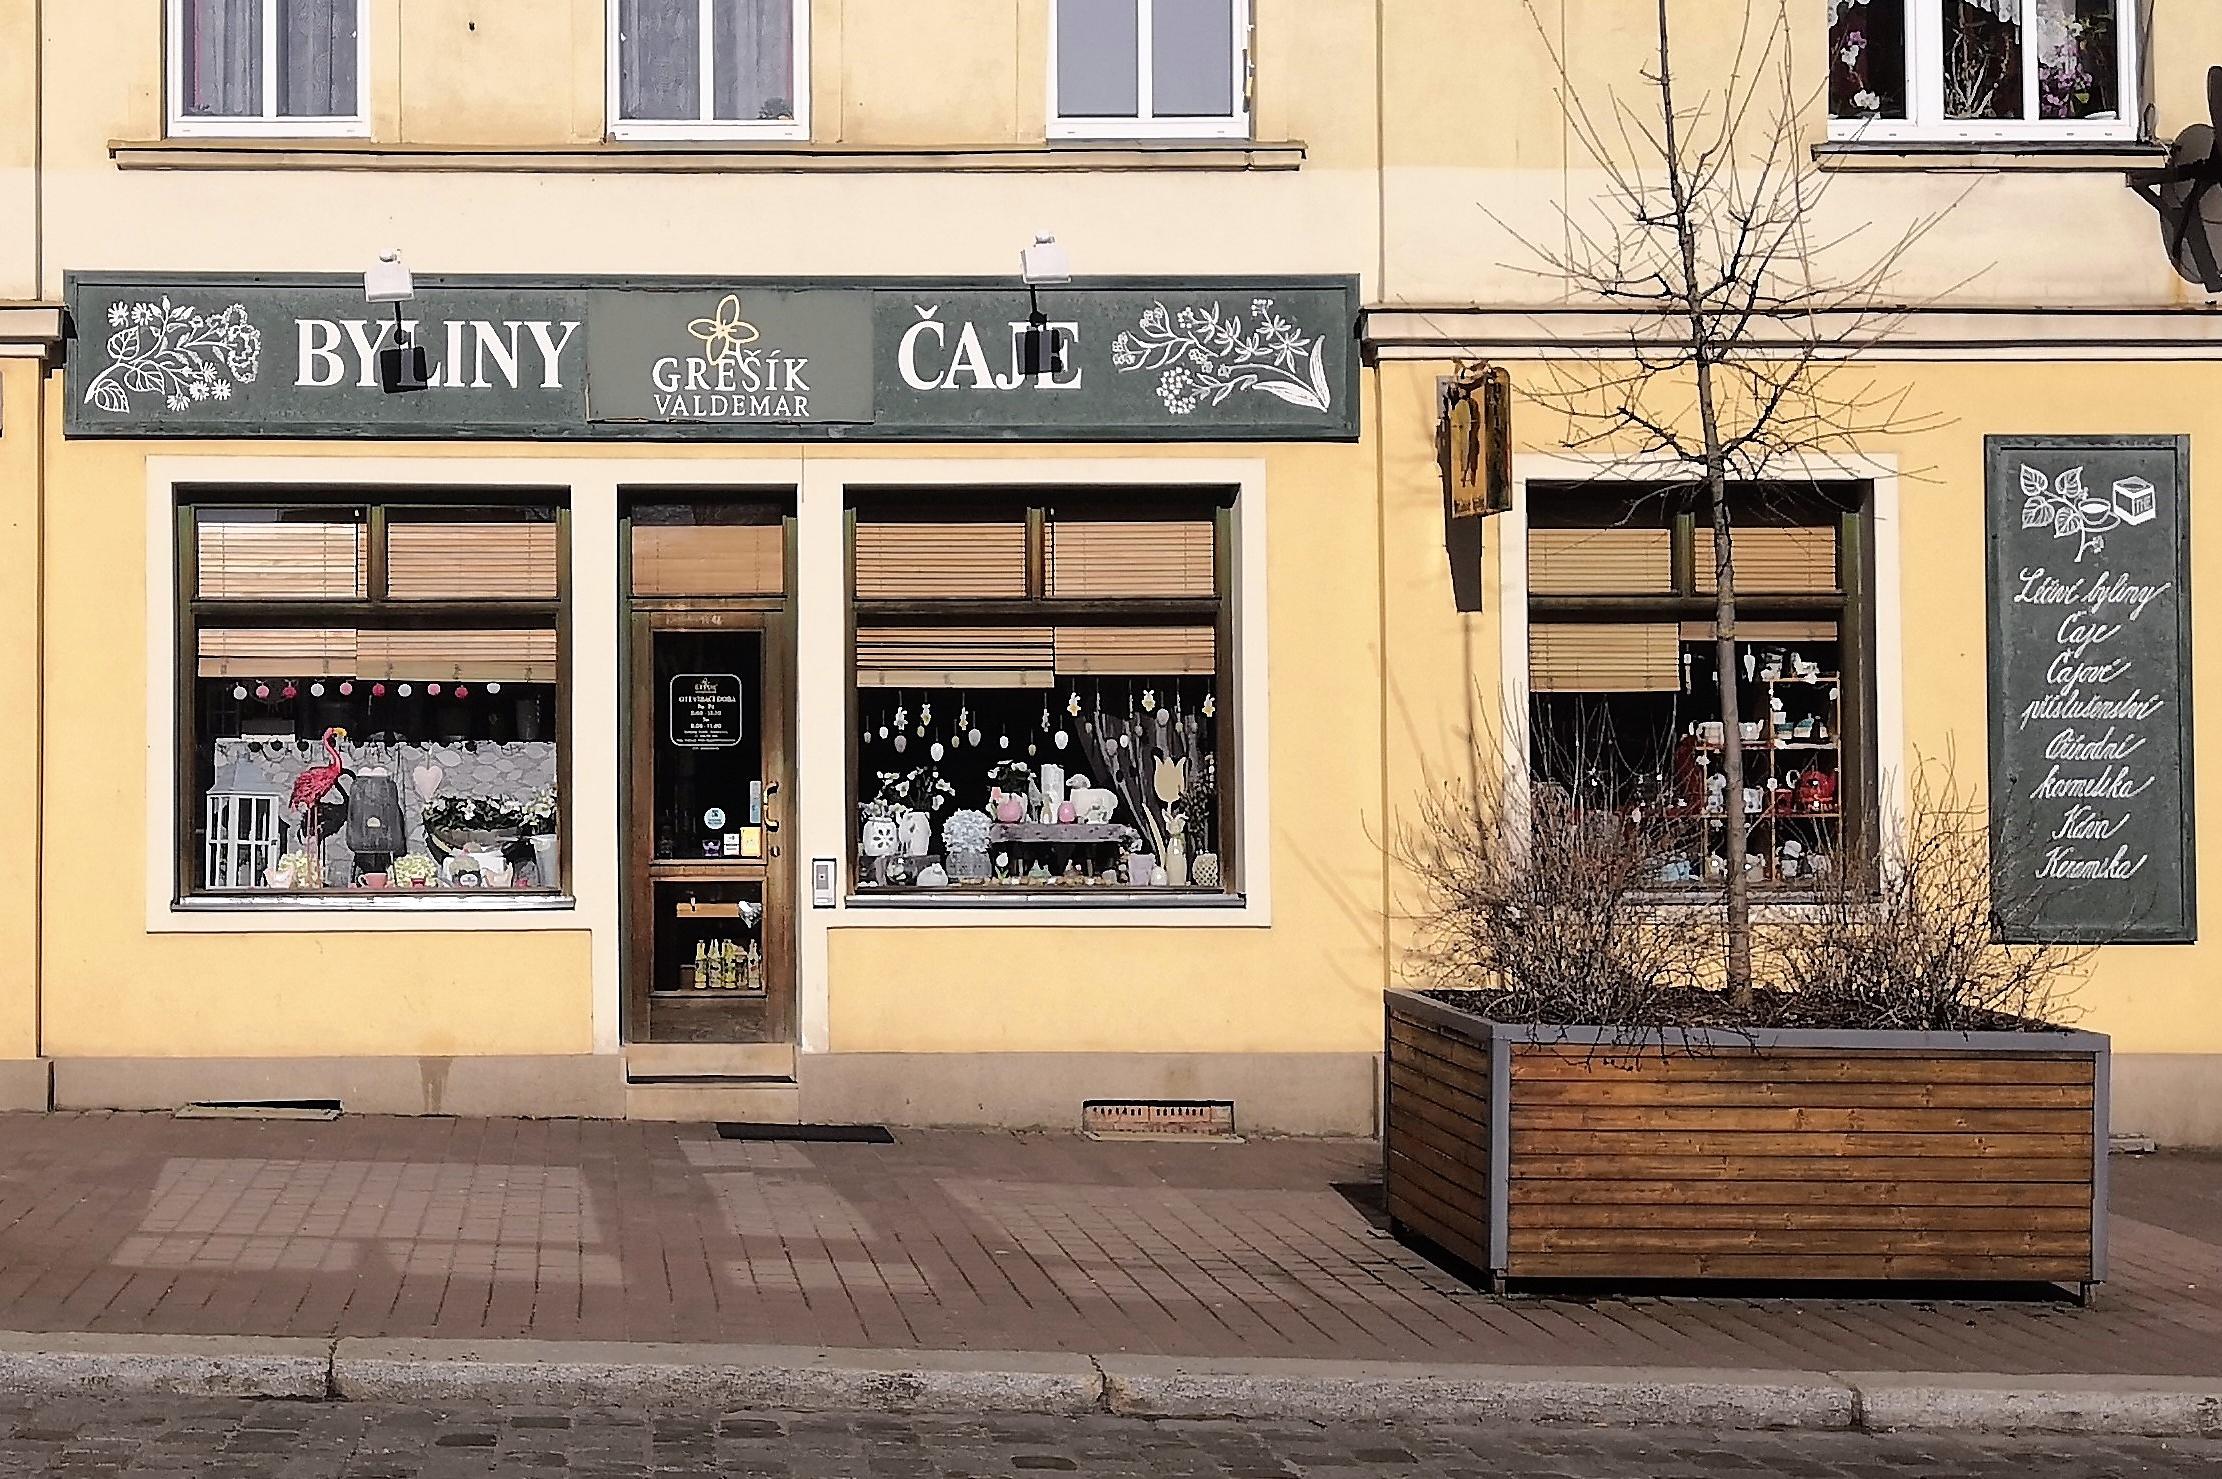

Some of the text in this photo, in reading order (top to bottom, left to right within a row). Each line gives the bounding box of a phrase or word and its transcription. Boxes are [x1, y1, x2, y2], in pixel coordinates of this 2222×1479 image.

[292, 318, 582, 389] BYLINY
[898, 304, 1082, 390] ČAJE
[652, 348, 811, 393] GREŠÍK
[653, 394, 810, 417] VALDEMAR
[2080, 570, 2172, 621] byliny
[2057, 610, 2123, 659] Čaje
[2046, 647, 2133, 697] Čajové
[2045, 726, 2147, 760] Přírodní
[2029, 764, 2156, 799] kosmetika
[2052, 803, 2131, 840] Káva
[2034, 844, 2148, 880] Keramika
